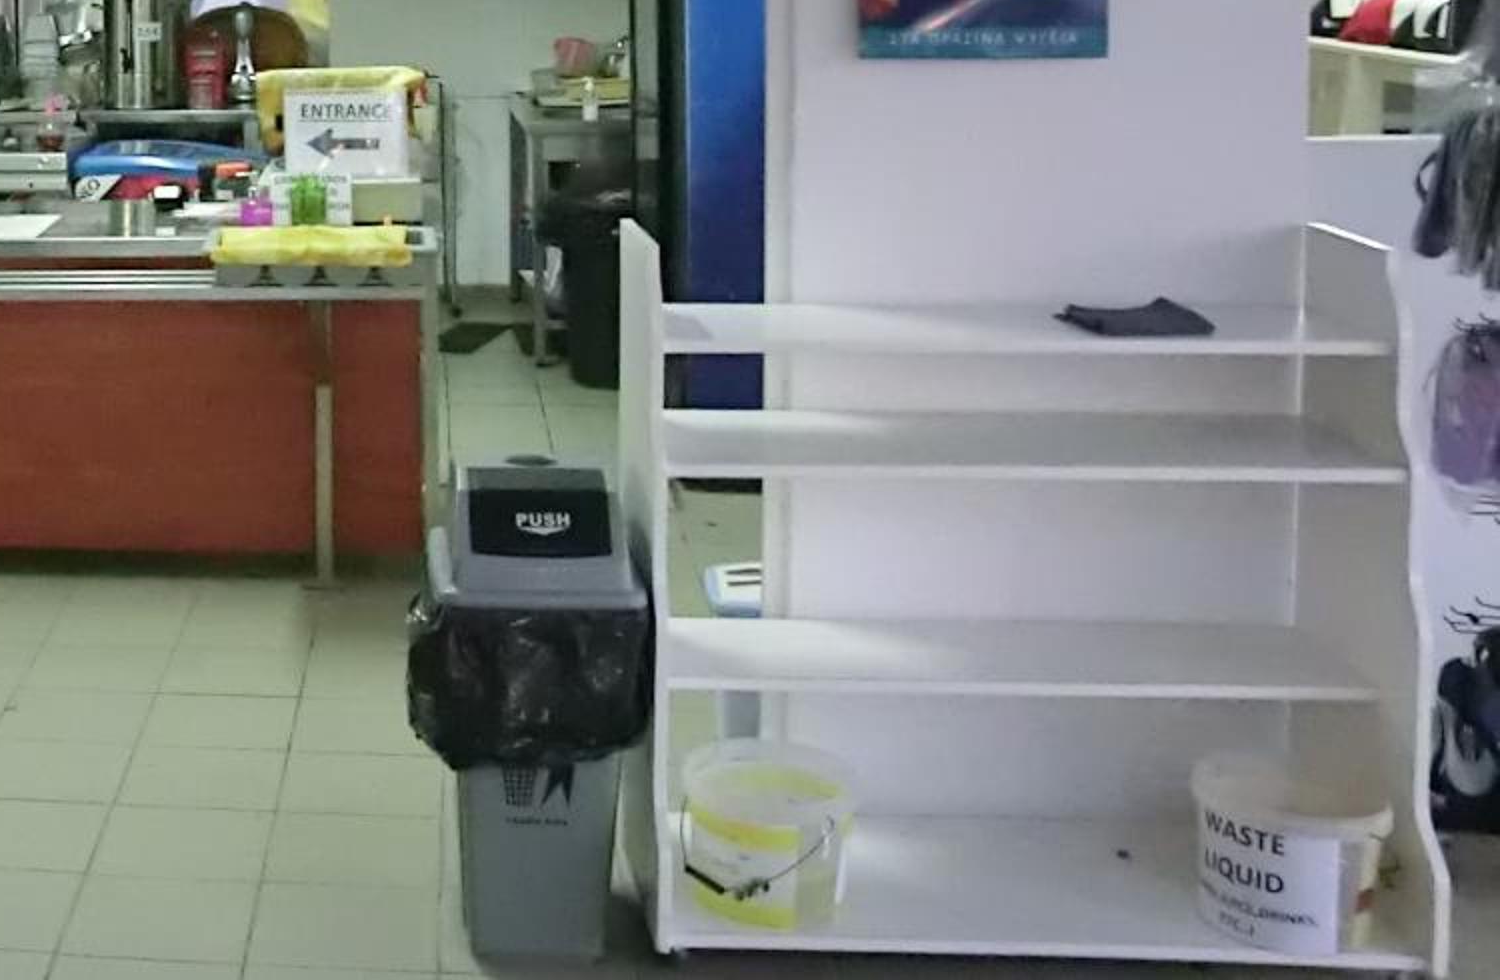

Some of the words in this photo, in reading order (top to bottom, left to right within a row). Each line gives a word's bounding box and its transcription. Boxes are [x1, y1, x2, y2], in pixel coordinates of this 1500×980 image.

[515, 512, 571, 528] PUSH
[1204, 809, 1285, 856] WASTE
[1204, 846, 1284, 893] LIQUID
